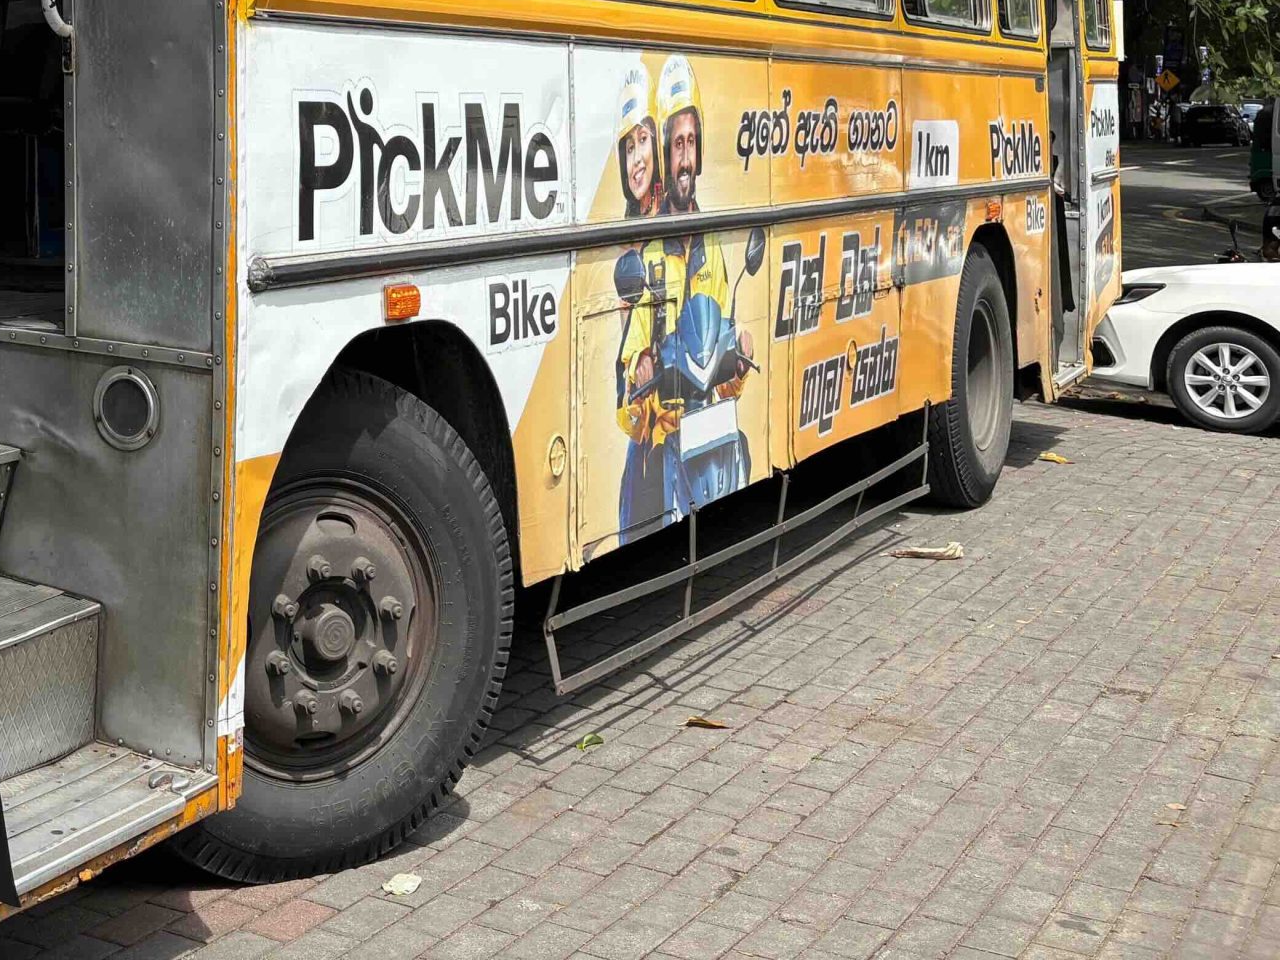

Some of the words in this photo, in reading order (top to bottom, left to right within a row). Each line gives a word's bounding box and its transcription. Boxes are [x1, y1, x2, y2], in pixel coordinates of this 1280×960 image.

[989, 117, 1041, 178] PickMe
[1091, 107, 1116, 139] PickMe
[298, 87, 558, 242] PickMe
[1026, 197, 1045, 232] Bike
[489, 282, 557, 346] Bike
